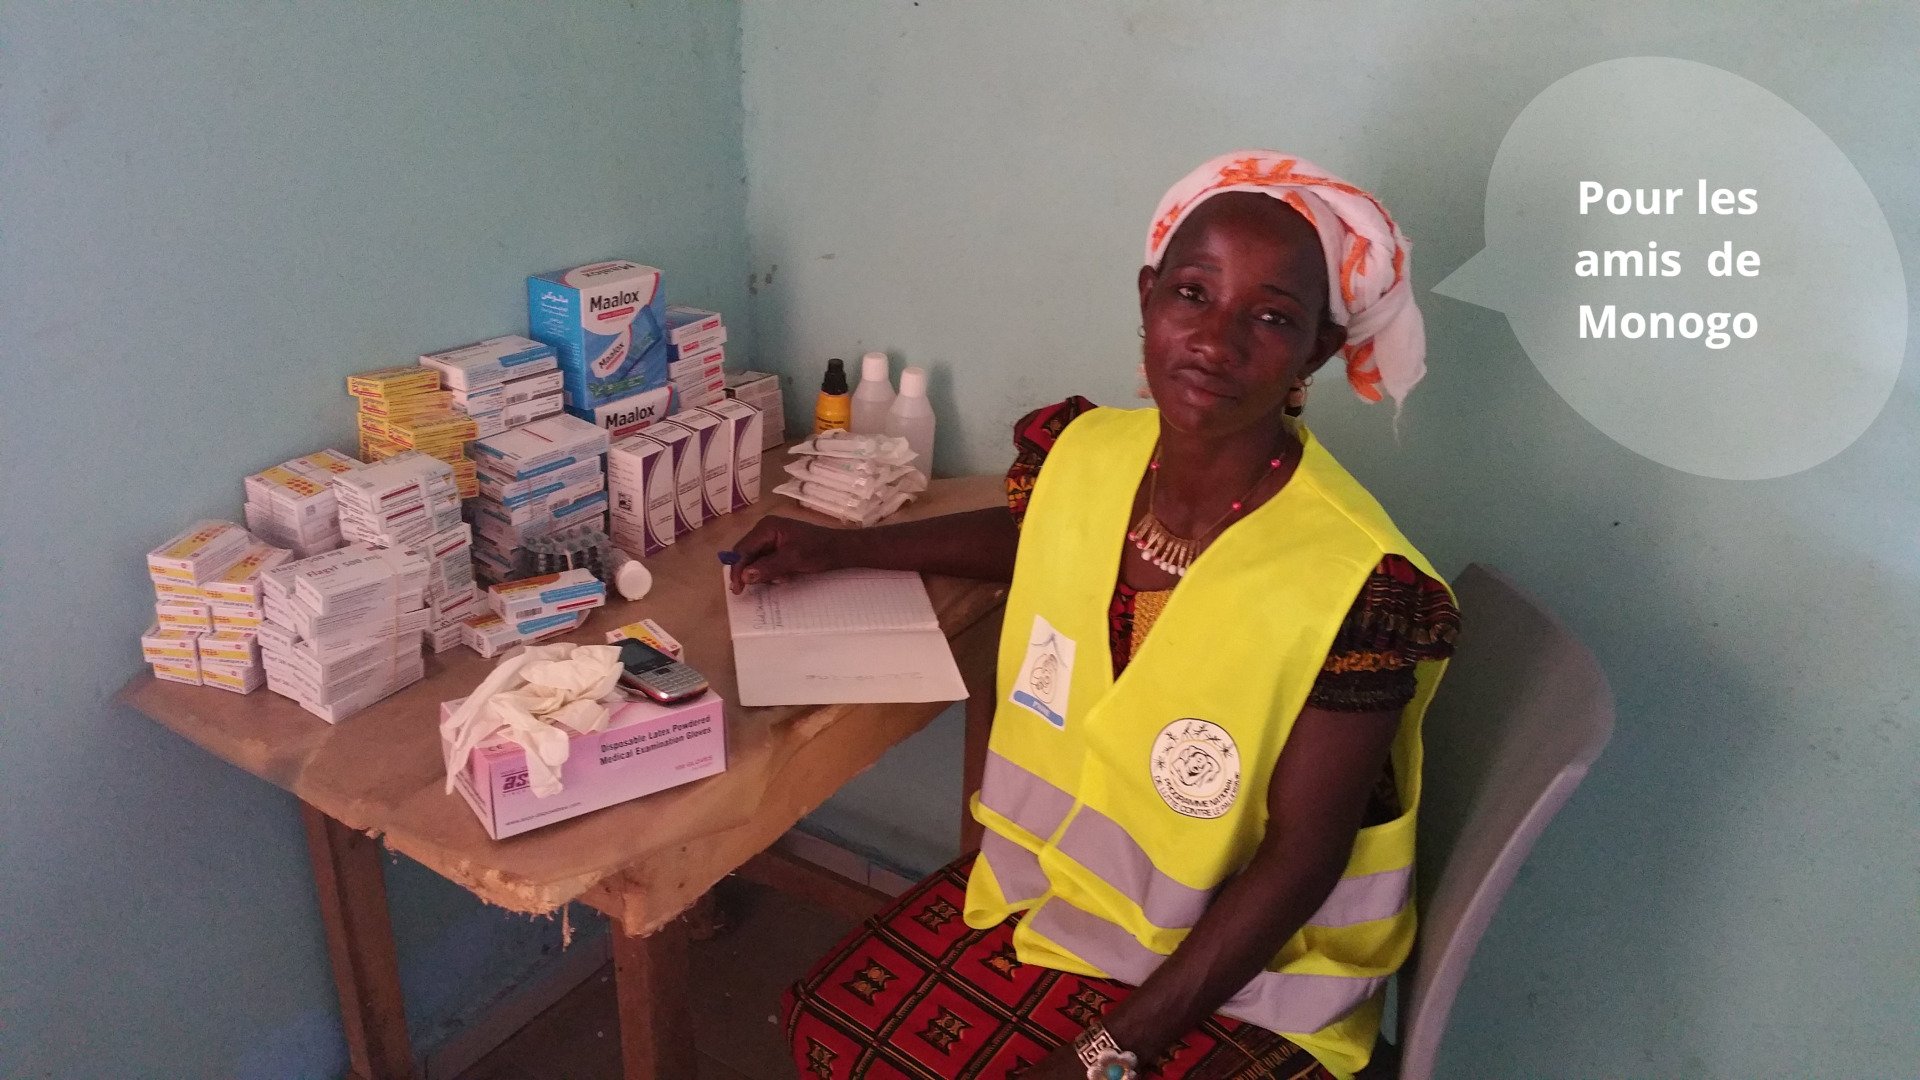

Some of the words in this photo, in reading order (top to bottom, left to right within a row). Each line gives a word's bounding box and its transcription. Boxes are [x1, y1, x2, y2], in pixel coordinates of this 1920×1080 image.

[589, 290, 640, 312] Maalox
[598, 342, 625, 370] Maalox
[605, 404, 656, 429] Maalox
[342, 557, 363, 568] 500
[599, 748, 634, 766] Medical
[635, 734, 685, 756] Examination
[686, 726, 712, 740] Gloves
[600, 734, 647, 753] Disposable
[648, 728, 671, 740] Latex
[672, 714, 712, 733] Powdered
